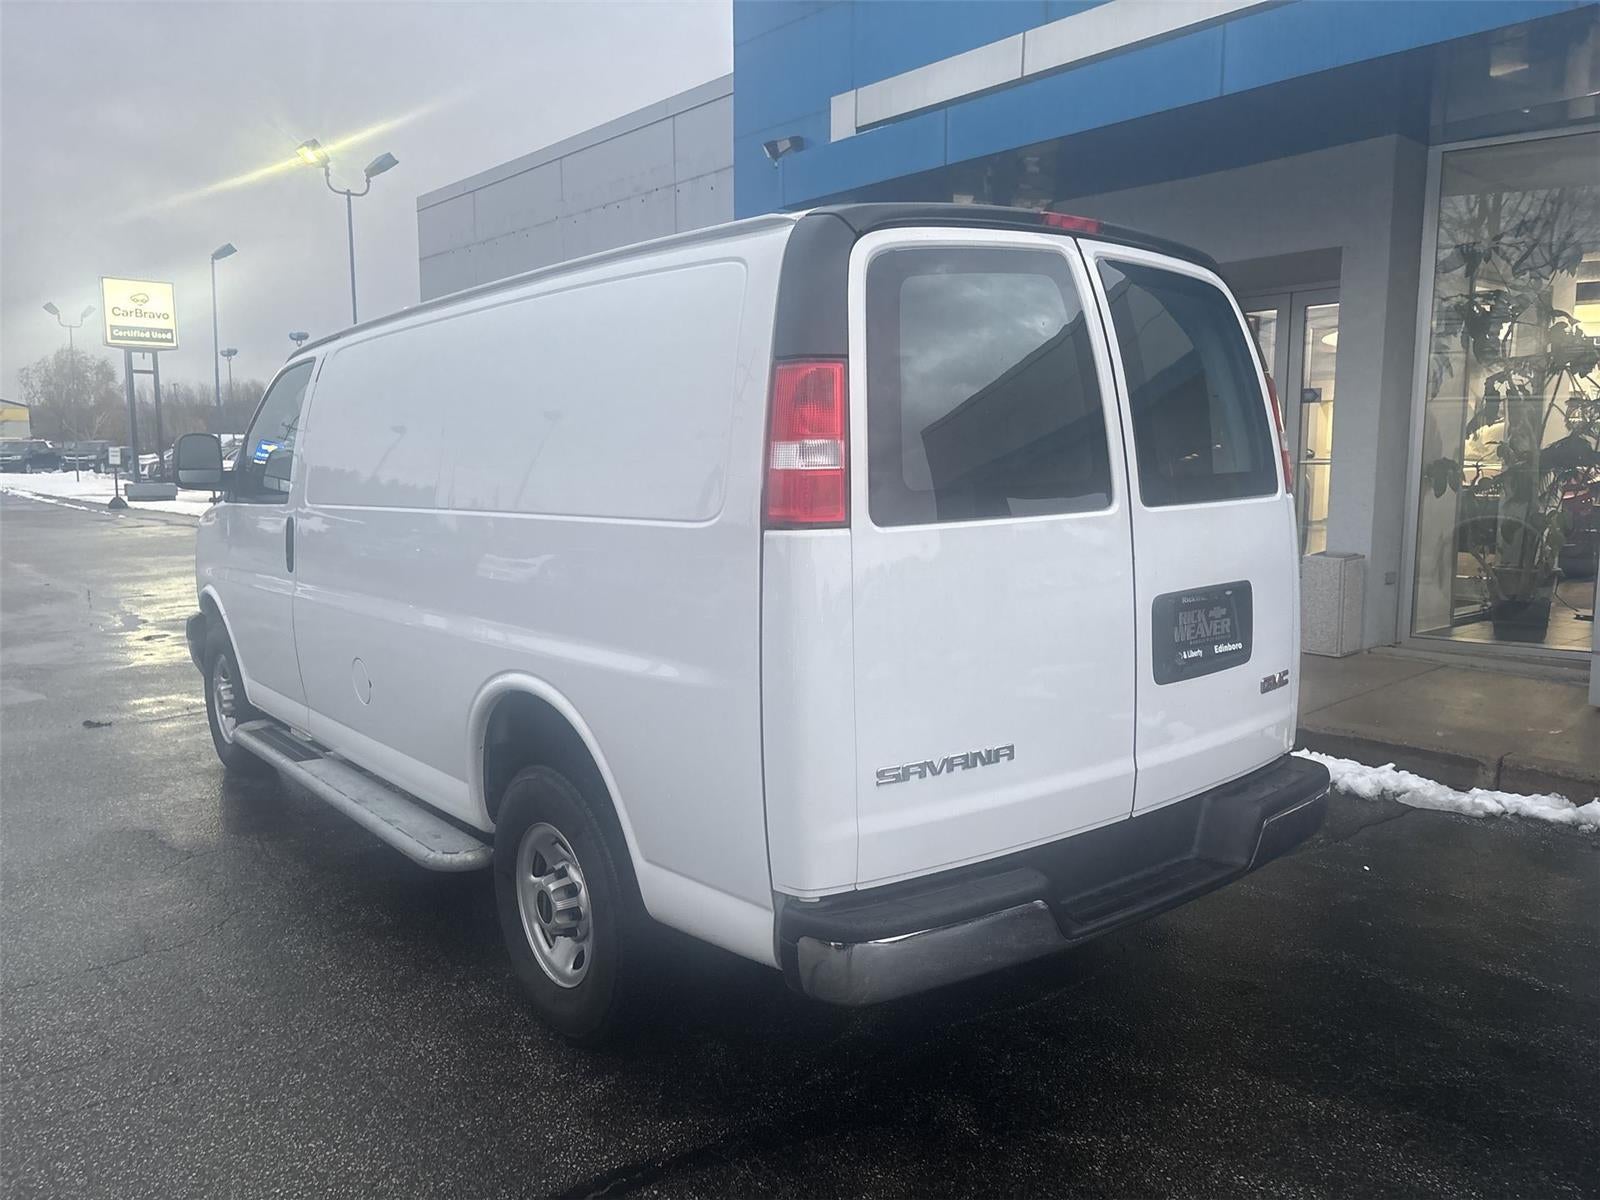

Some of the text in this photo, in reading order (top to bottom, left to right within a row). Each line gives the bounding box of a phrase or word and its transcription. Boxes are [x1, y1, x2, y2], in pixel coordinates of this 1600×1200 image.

[112, 307, 169, 320] CarBravo
[113, 329, 172, 339] Certified Used
[1178, 608, 1207, 626] RICK
[1174, 618, 1231, 643] WEAVER
[1187, 649, 1203, 659] Liberty
[1214, 642, 1243, 654] Edinboro
[876, 743, 1015, 787] SAVANA
